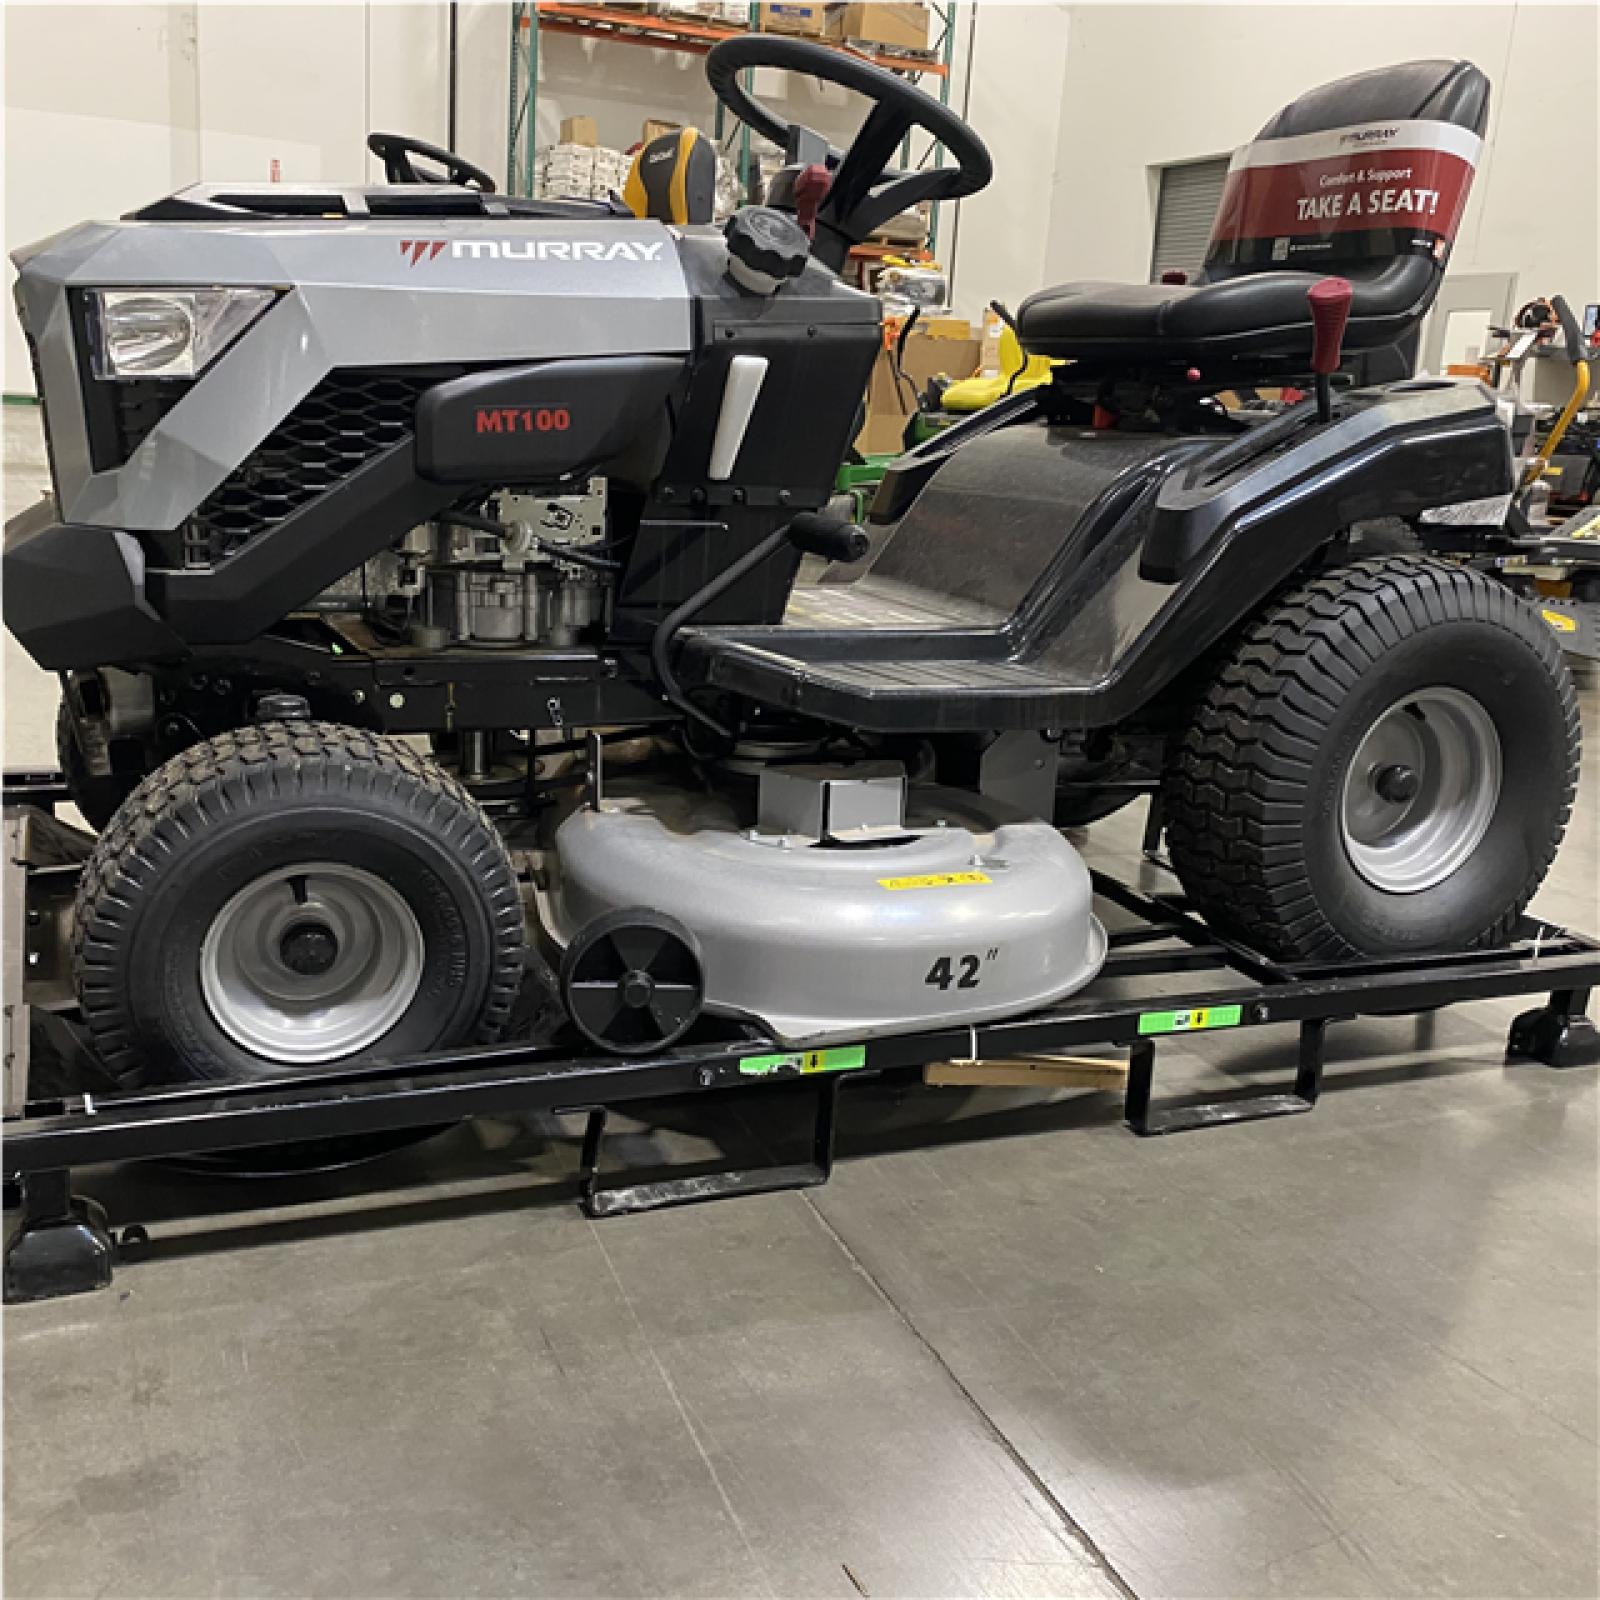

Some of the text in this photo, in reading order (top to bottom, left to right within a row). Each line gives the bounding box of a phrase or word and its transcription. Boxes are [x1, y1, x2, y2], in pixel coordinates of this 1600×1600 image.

[1357, 169, 1366, 183] &
[1367, 167, 1412, 184] Support
[1297, 187, 1440, 221] TAKE A SEAT!
[476, 408, 571, 433] MT100
